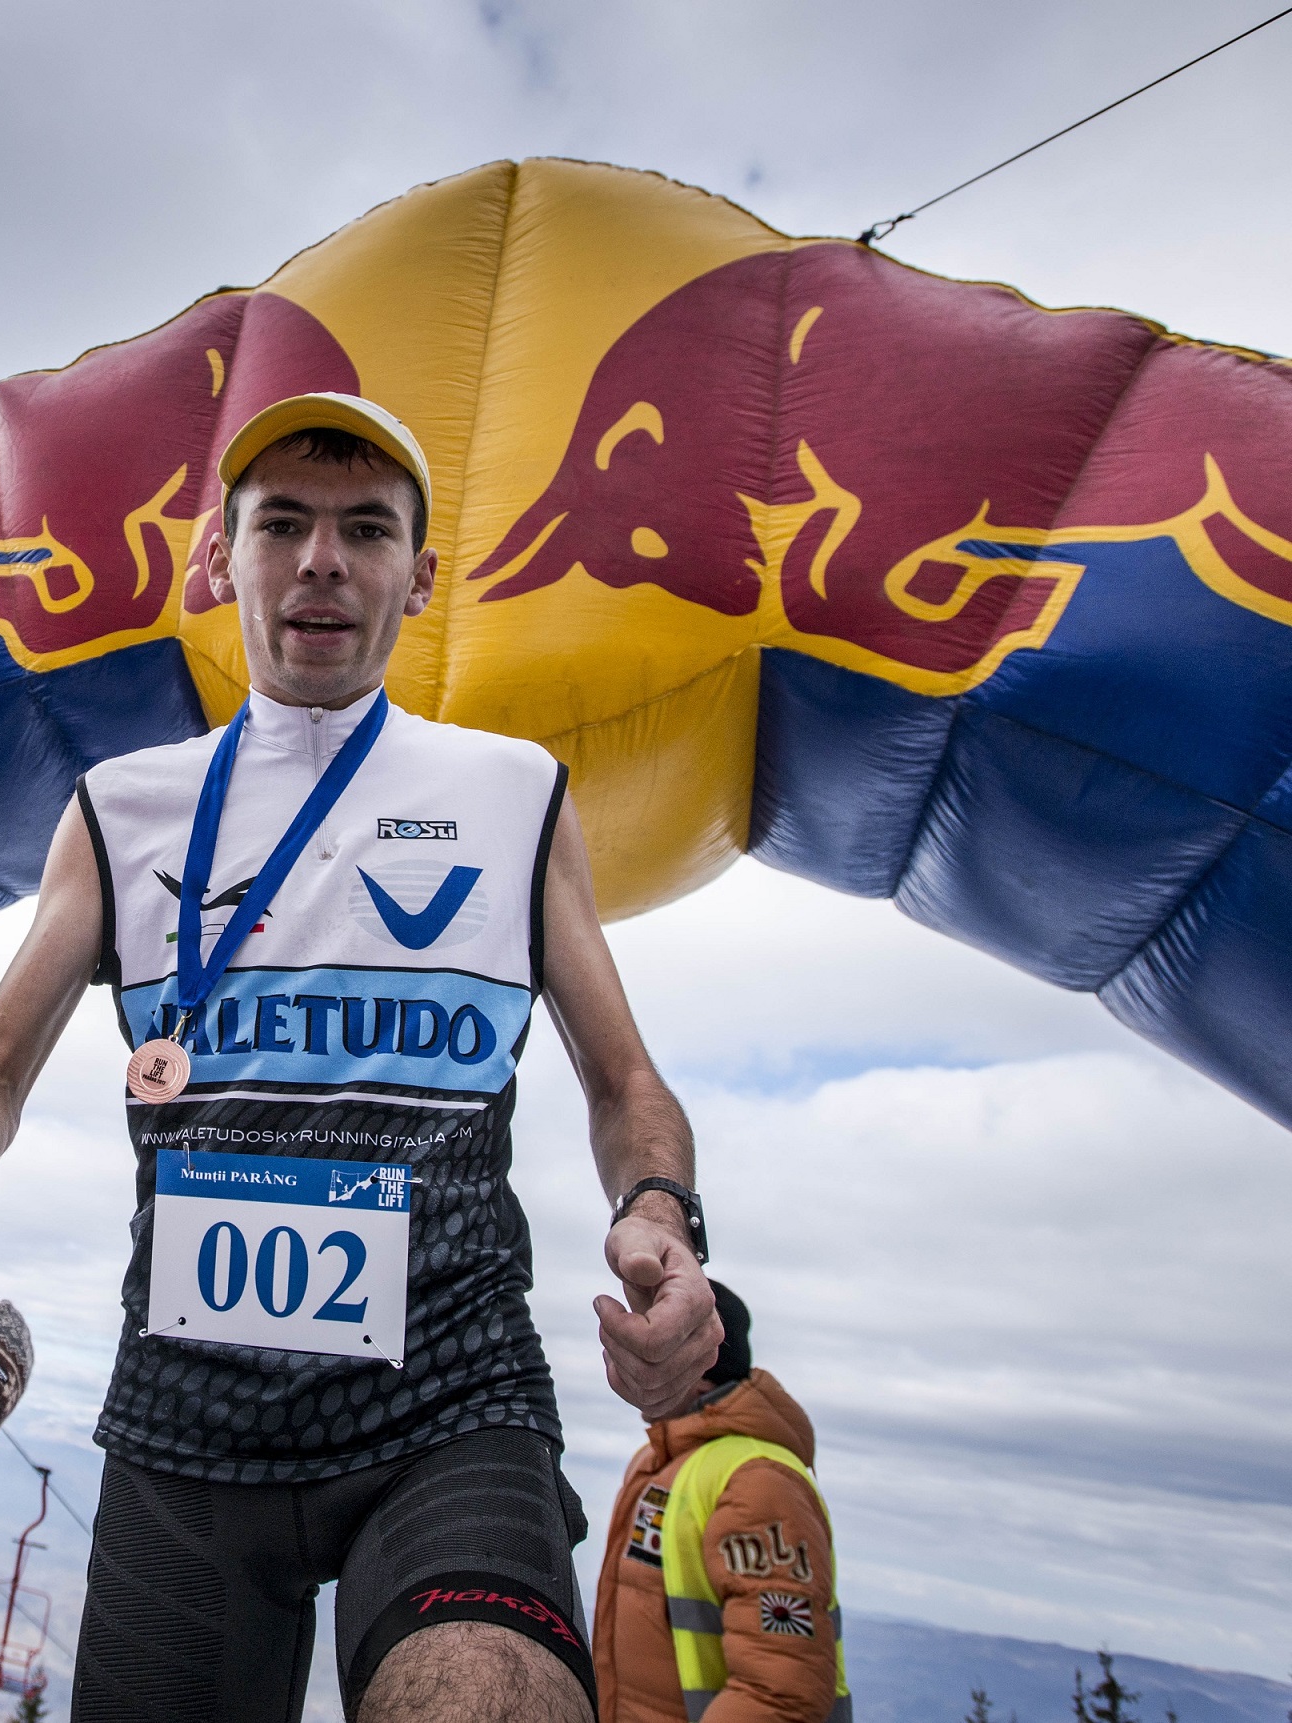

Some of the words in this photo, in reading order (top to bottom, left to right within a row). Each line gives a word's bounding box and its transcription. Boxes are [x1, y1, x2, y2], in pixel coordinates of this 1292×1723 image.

[152, 1063, 166, 1073] THE
[154, 1057, 169, 1067] RUN
[149, 1069, 164, 1079] LIFT
[230, 1170, 298, 1187] PARÂNG
[379, 1166, 406, 1181] RUN
[379, 1180, 405, 1195] THE
[377, 1193, 405, 1208] LIFT
[197, 1221, 369, 1324] 002
